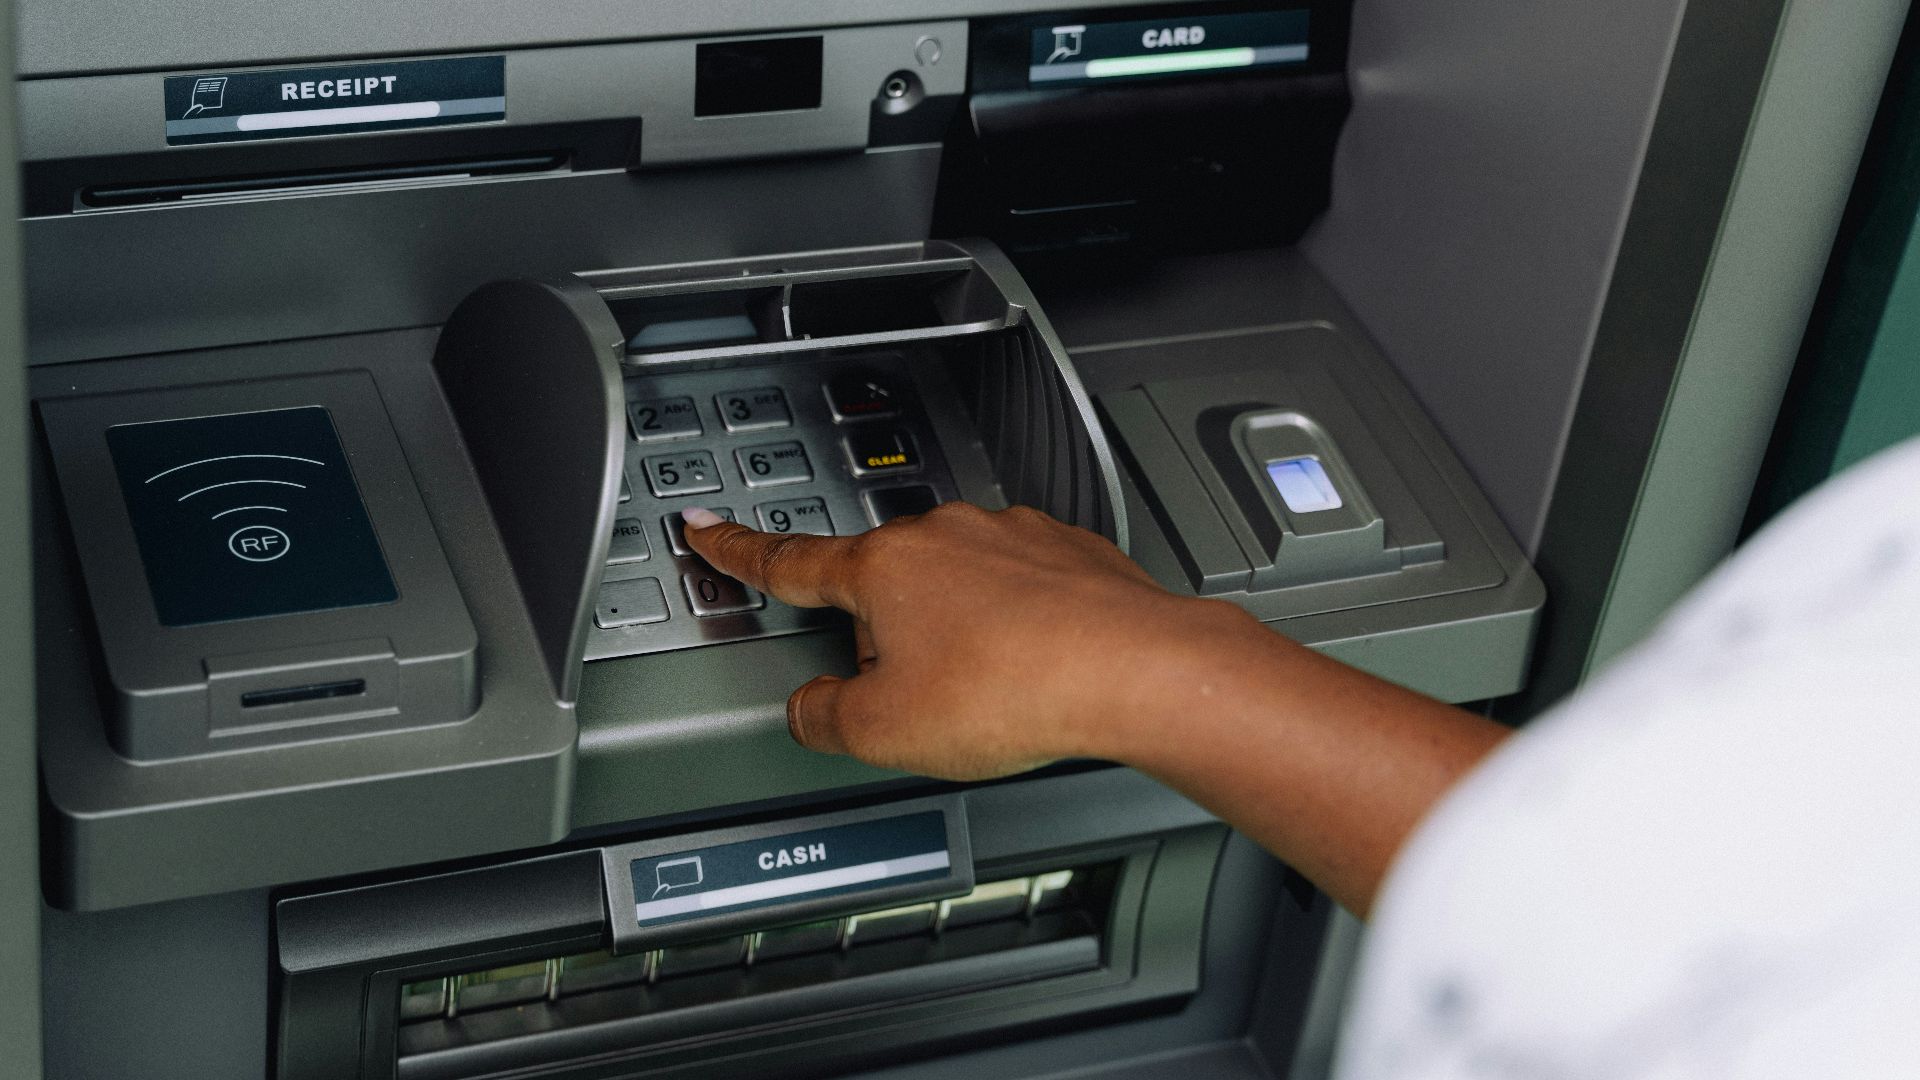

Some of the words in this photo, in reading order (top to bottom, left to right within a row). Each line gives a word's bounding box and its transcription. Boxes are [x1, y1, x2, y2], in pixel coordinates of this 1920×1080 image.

[1141, 25, 1206, 49] CARD
[281, 75, 398, 101] RECEIPT
[637, 407, 663, 431] 2
[664, 403, 693, 415] ABC
[728, 397, 752, 421] 3
[657, 461, 681, 486] 5
[683, 458, 709, 469] JKL
[749, 452, 772, 476] 6
[867, 453, 907, 467] CLEAR
[612, 526, 640, 538] PRS
[769, 509, 793, 533] 9
[240, 534, 280, 553] RF
[697, 577, 720, 603] 0
[758, 842, 827, 871] CASH
